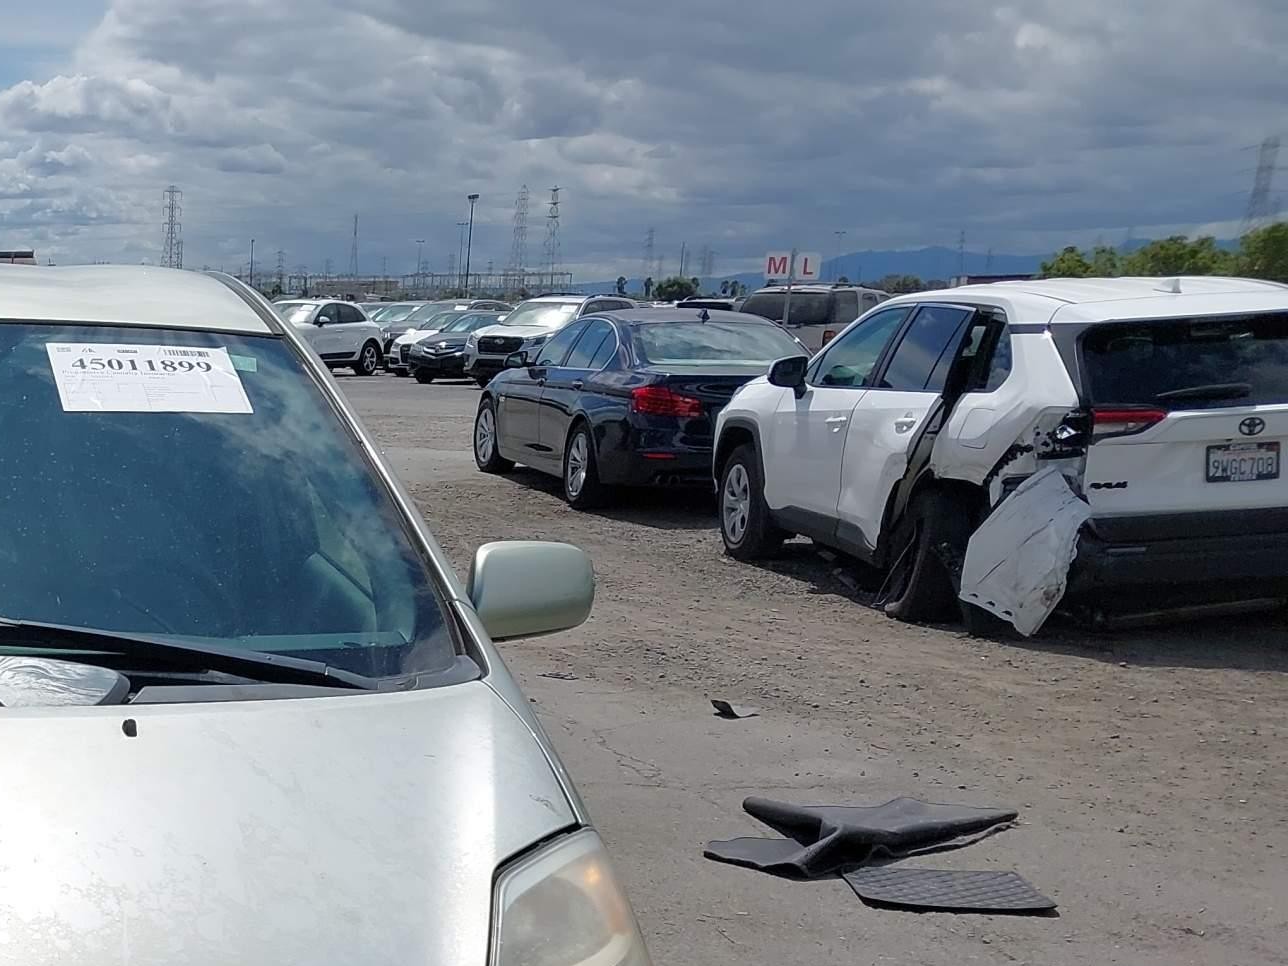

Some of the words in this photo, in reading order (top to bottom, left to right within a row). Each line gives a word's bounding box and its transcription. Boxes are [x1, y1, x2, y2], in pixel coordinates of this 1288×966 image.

[767, 256, 788, 274] M
[803, 257, 814, 275] L
[72, 357, 213, 373] 45011899
[1212, 456, 1275, 477] 9WGC708
